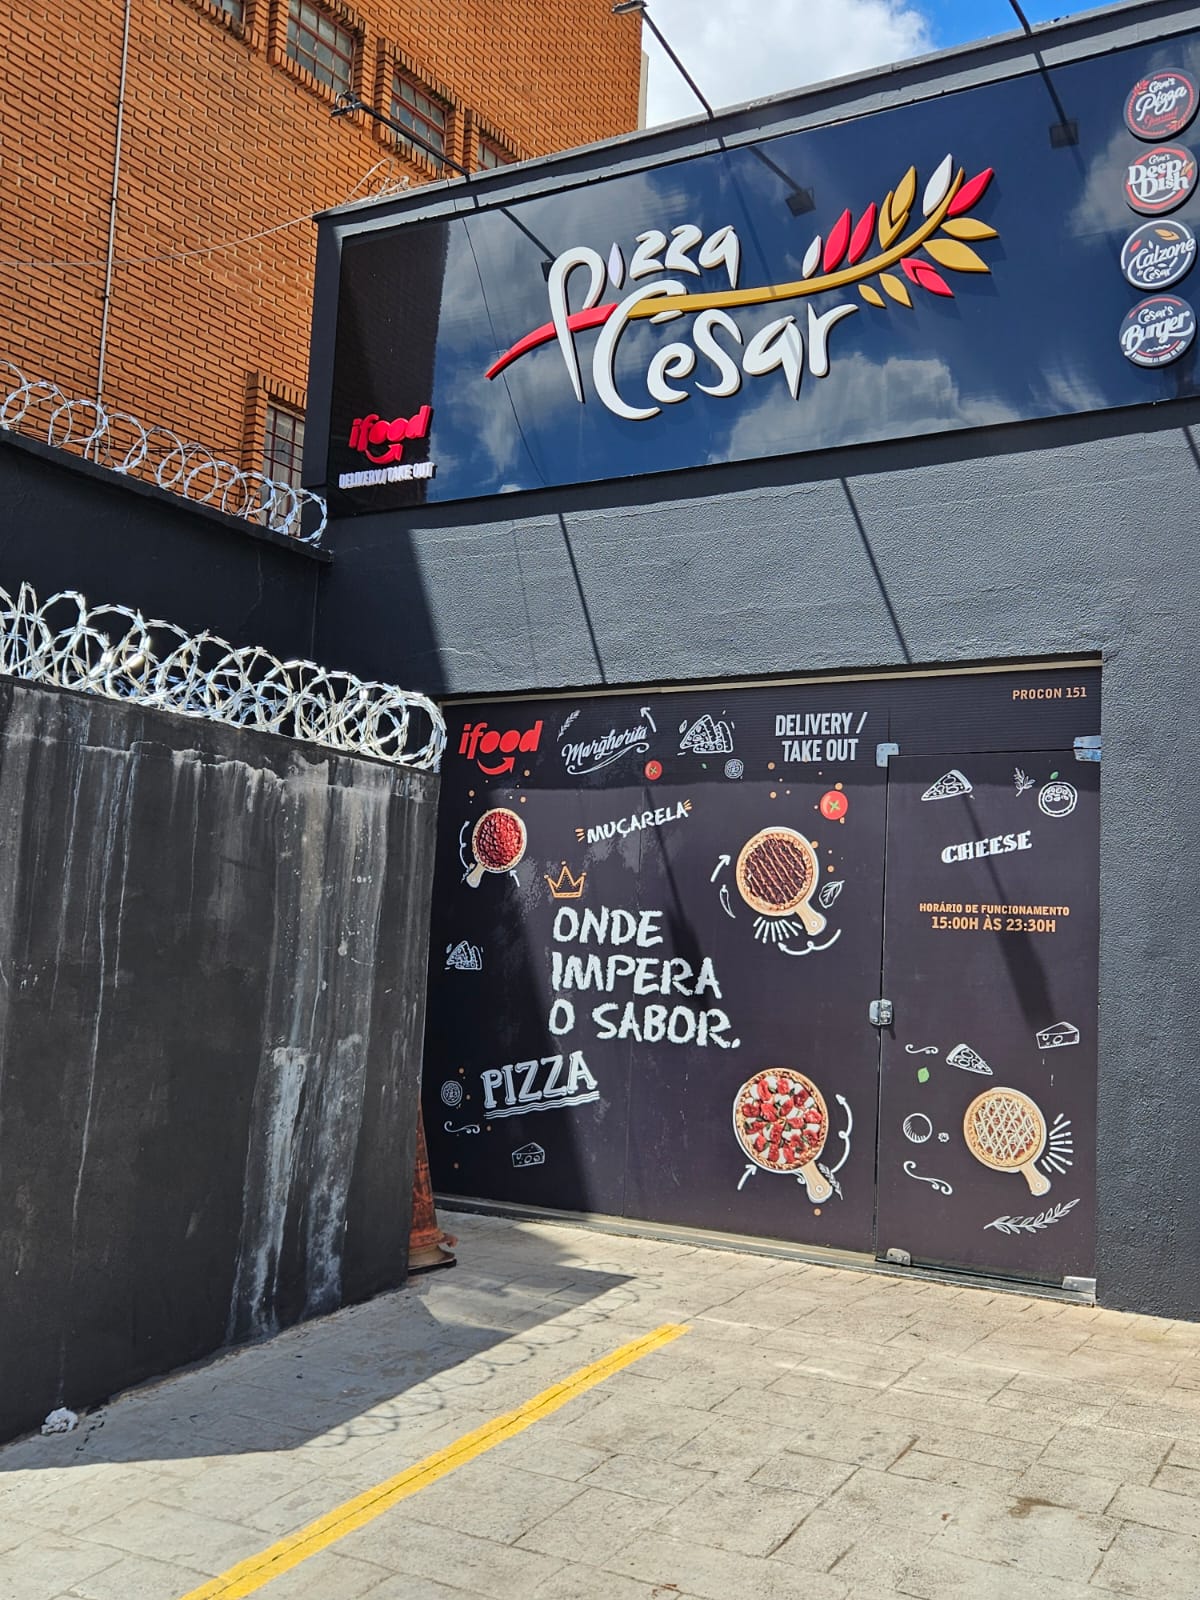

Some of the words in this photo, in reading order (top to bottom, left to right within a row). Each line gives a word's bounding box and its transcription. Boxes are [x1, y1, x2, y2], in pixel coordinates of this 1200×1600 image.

[1135, 86, 1188, 121] Pizza
[1128, 159, 1182, 185] Deep
[1140, 171, 1190, 198] Dish
[1135, 238, 1196, 269] Calzone
[548, 223, 740, 403] Pizza
[1138, 305, 1174, 325] Cesar's
[1121, 310, 1190, 356] Burger
[592, 280, 859, 421] Cesar
[387, 464, 413, 482] TAKE
[413, 461, 435, 479] OUT
[1012, 688, 1062, 700] PROCON
[1066, 687, 1087, 698] 151
[458, 720, 543, 760] ifood
[775, 712, 853, 736] DELIVERY
[782, 739, 822, 762] TAKE
[826, 738, 859, 761] OUT
[587, 802, 689, 843] MUÇARELA
[941, 830, 1033, 864] CHEESE
[919, 901, 962, 913] HORÁRIO
[965, 904, 979, 913] DE
[981, 904, 1070, 916] FUNCIONAMENTO
[931, 916, 979, 930] 15:00H
[983, 914, 1002, 931] ÀS
[1006, 918, 1056, 932] 23:30H
[553, 905, 664, 947] ONDE
[551, 952, 722, 999] IMPERA
[549, 999, 575, 1035] O
[592, 1002, 741, 1049] SABOR.
[480, 1050, 598, 1109] PIZZA
